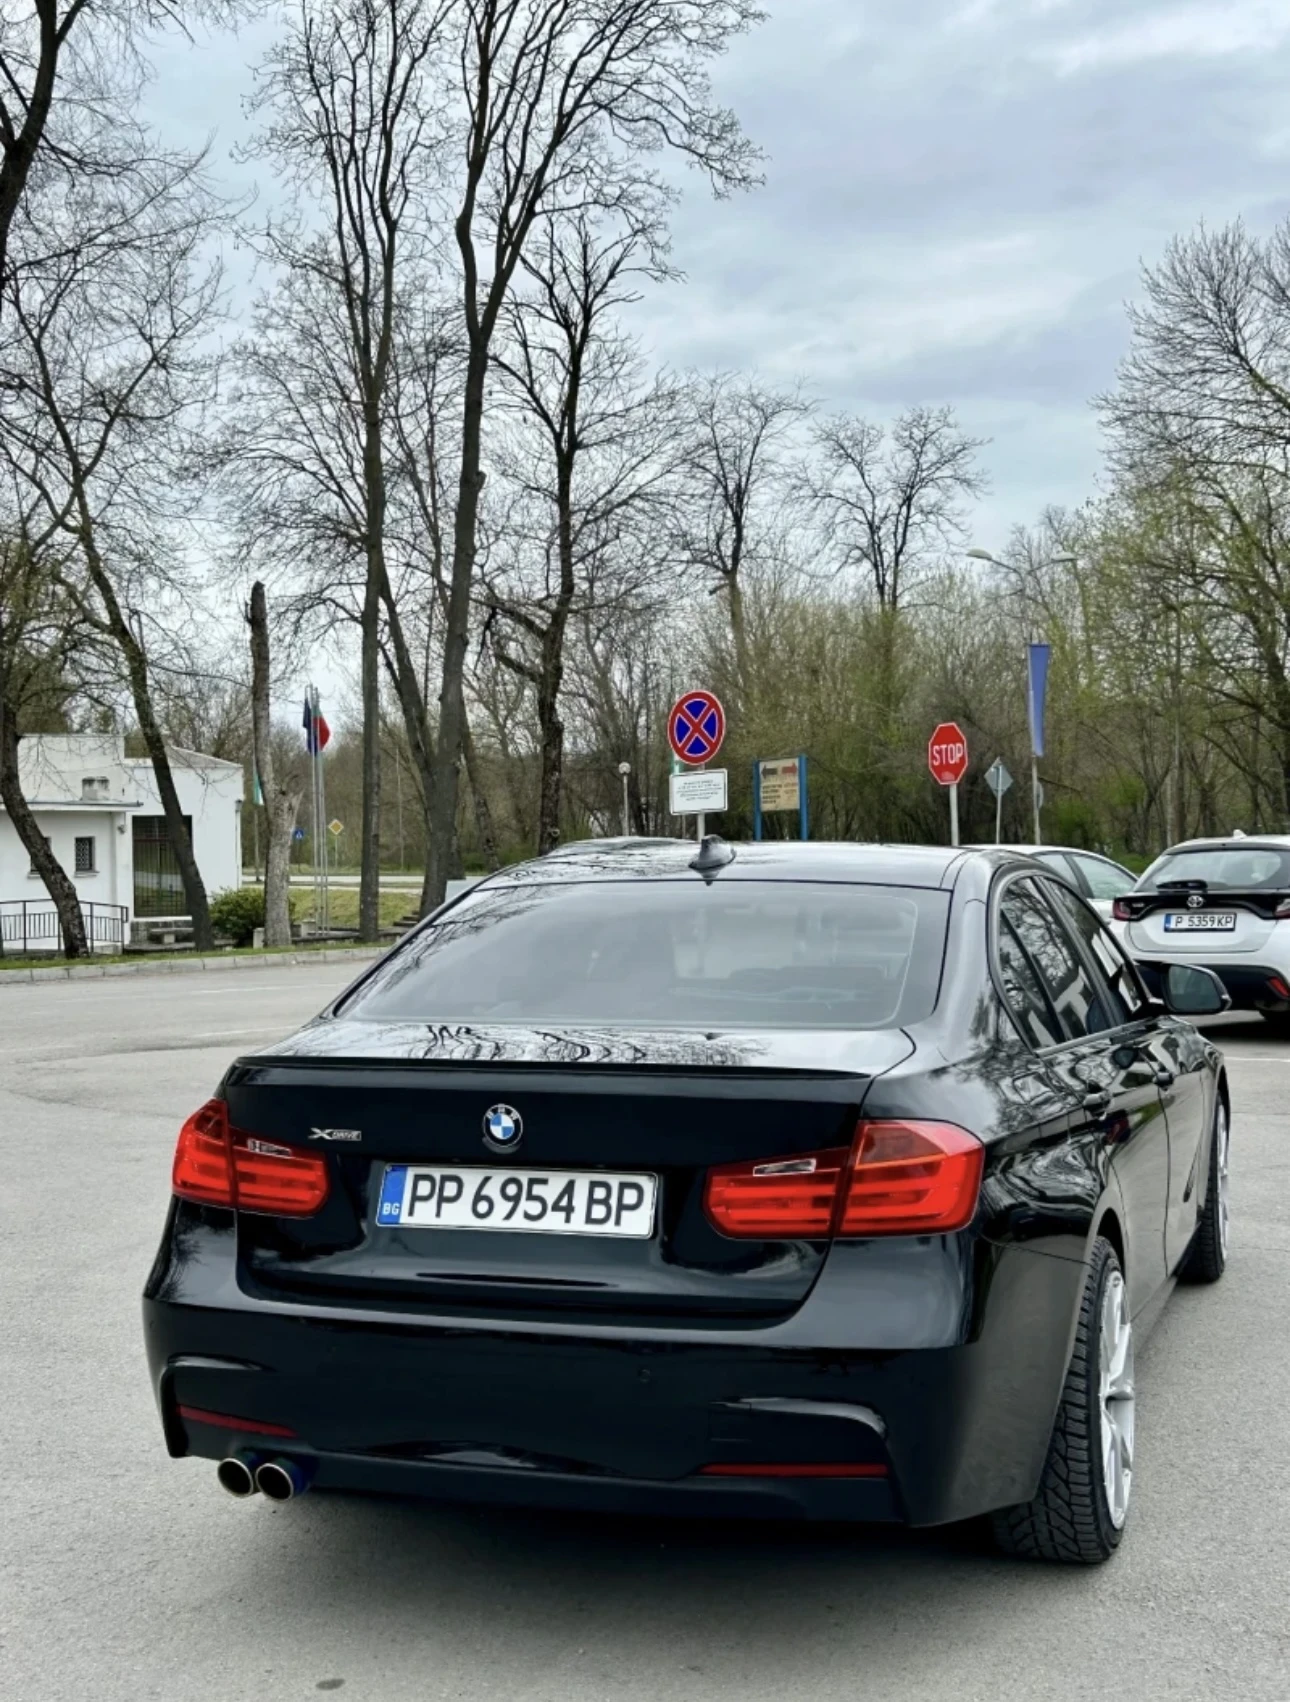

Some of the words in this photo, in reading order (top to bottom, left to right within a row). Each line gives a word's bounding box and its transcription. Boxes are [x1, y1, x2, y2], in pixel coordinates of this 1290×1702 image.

[933, 743, 963, 766] STOP
[1175, 916, 1183, 927] P
[1188, 916, 1215, 927] 5359
[1217, 916, 1232, 927] KP
[407, 1173, 464, 1218] PP
[471, 1176, 577, 1223] 6954
[584, 1180, 645, 1226] BP
[382, 1202, 400, 1216] BG
